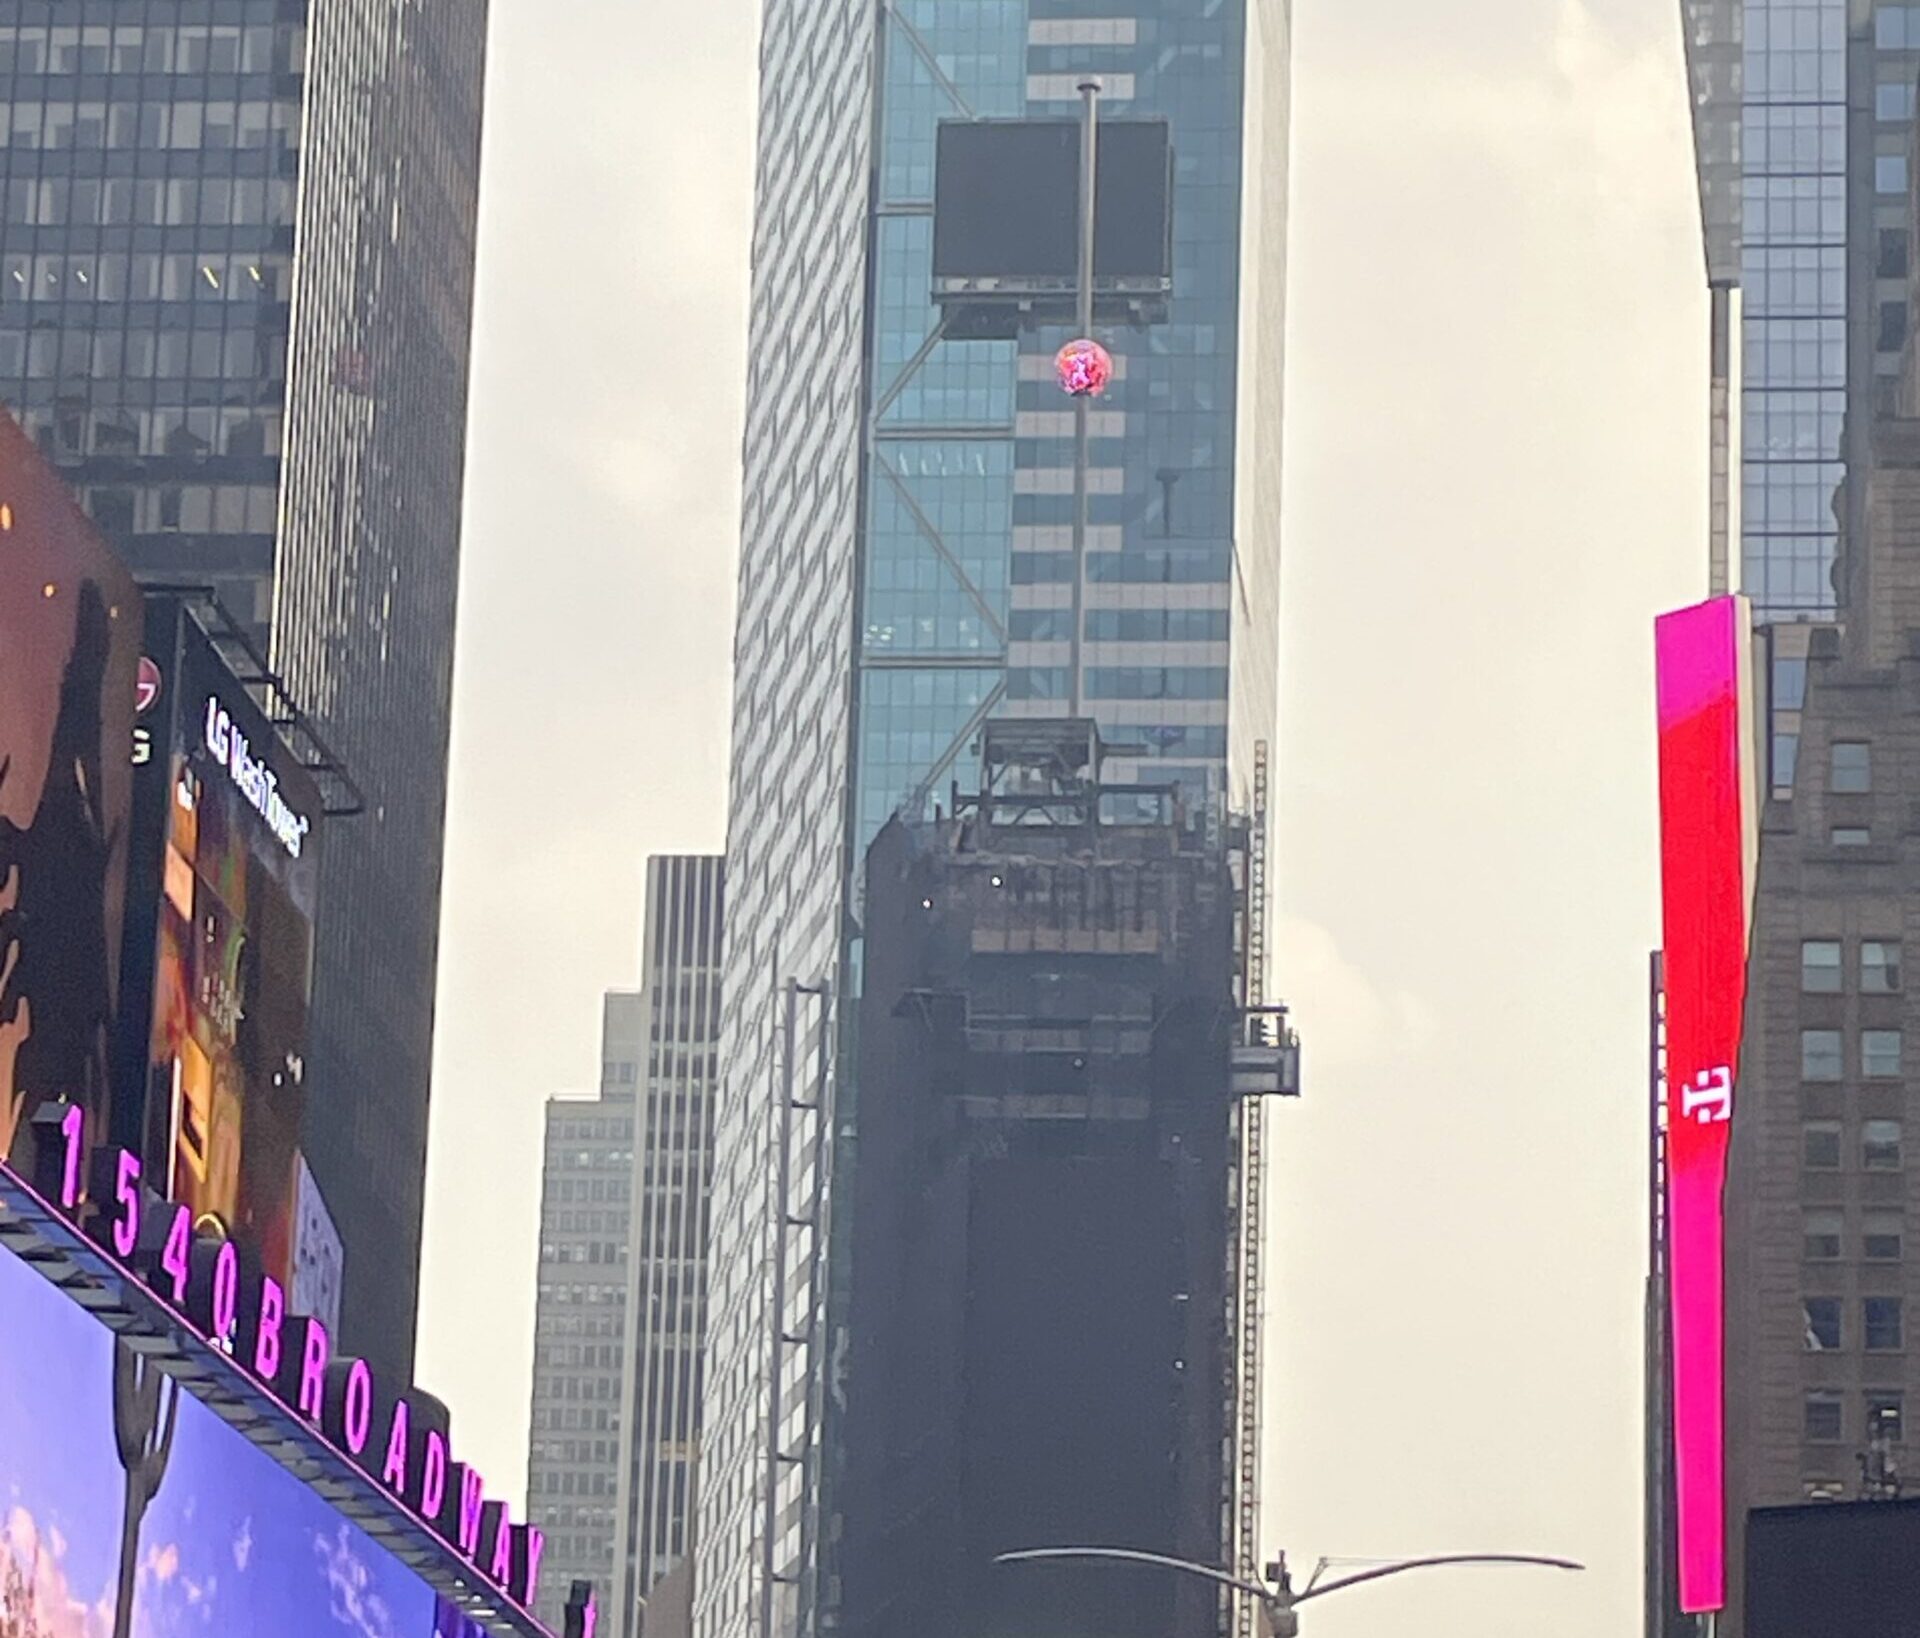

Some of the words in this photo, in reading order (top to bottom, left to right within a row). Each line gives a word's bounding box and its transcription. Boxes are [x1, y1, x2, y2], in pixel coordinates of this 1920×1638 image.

[207, 697, 230, 765] LG
[62, 1104, 238, 1339] 1540
[255, 1276, 544, 1606] BROADWAY
